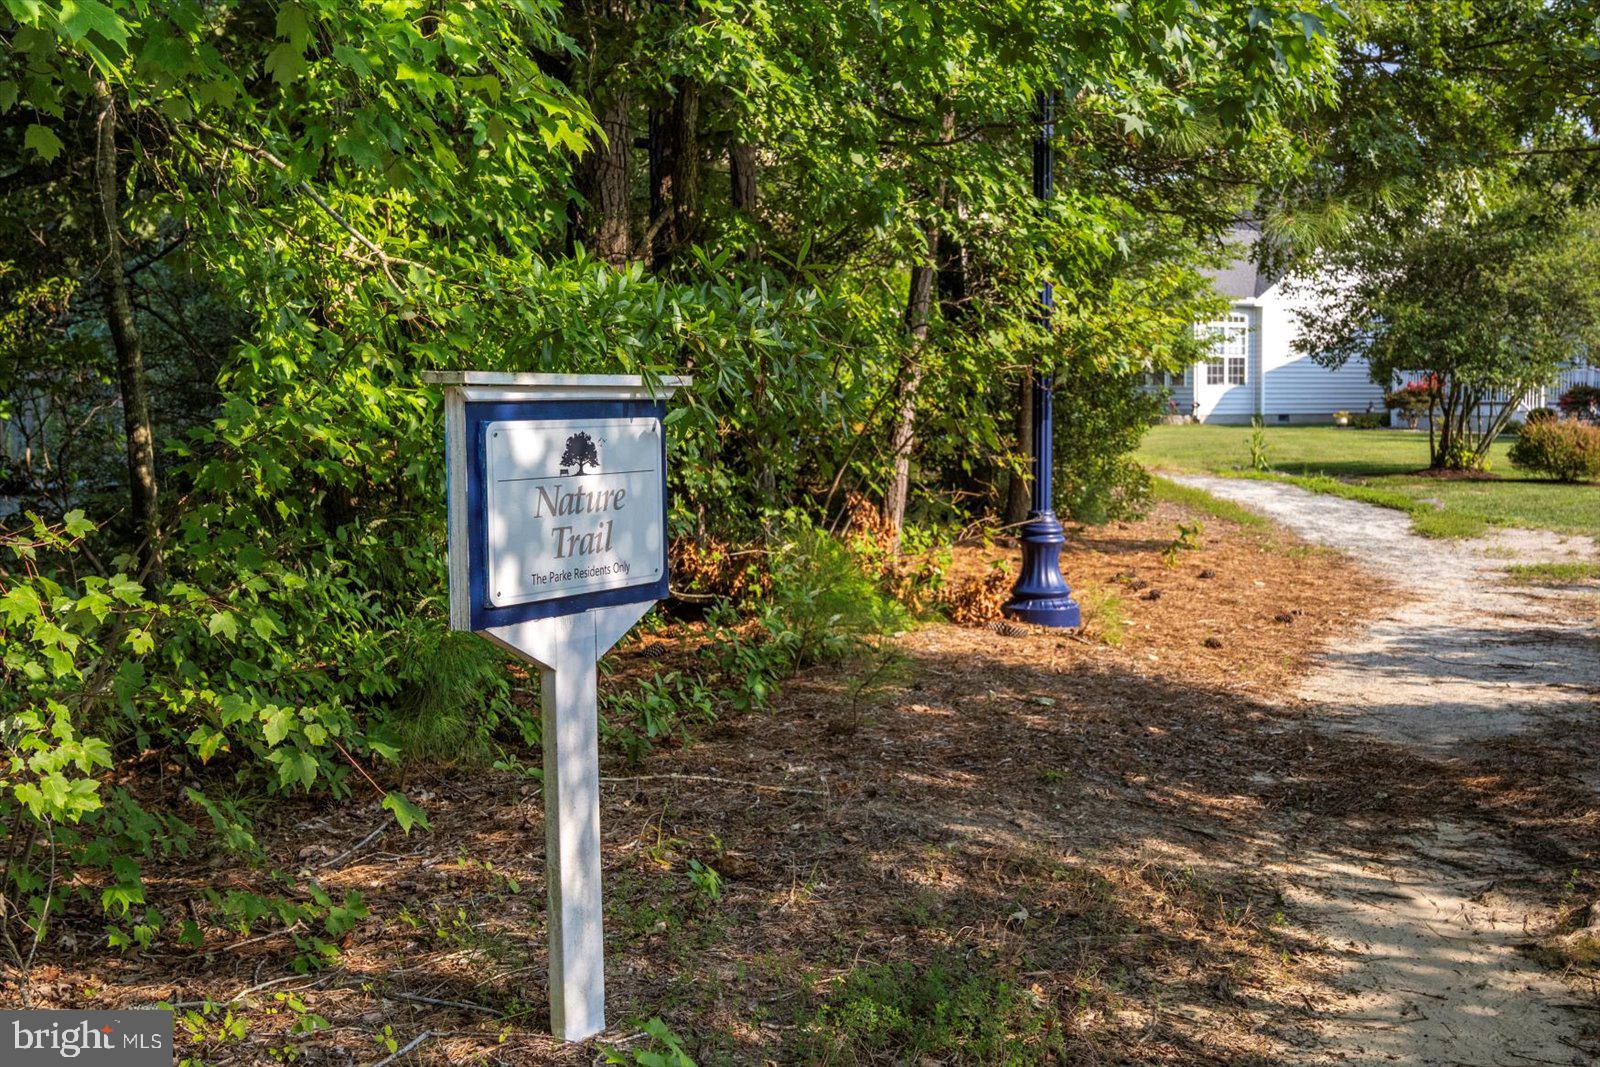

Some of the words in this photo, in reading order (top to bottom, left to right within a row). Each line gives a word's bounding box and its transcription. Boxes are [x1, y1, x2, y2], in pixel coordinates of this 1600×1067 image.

[533, 484, 626, 519] Nature
[551, 519, 613, 559] Trail
[532, 573, 547, 585] The
[549, 569, 572, 583] Parke
[574, 565, 611, 580] Residents
[613, 560, 630, 575] Only
